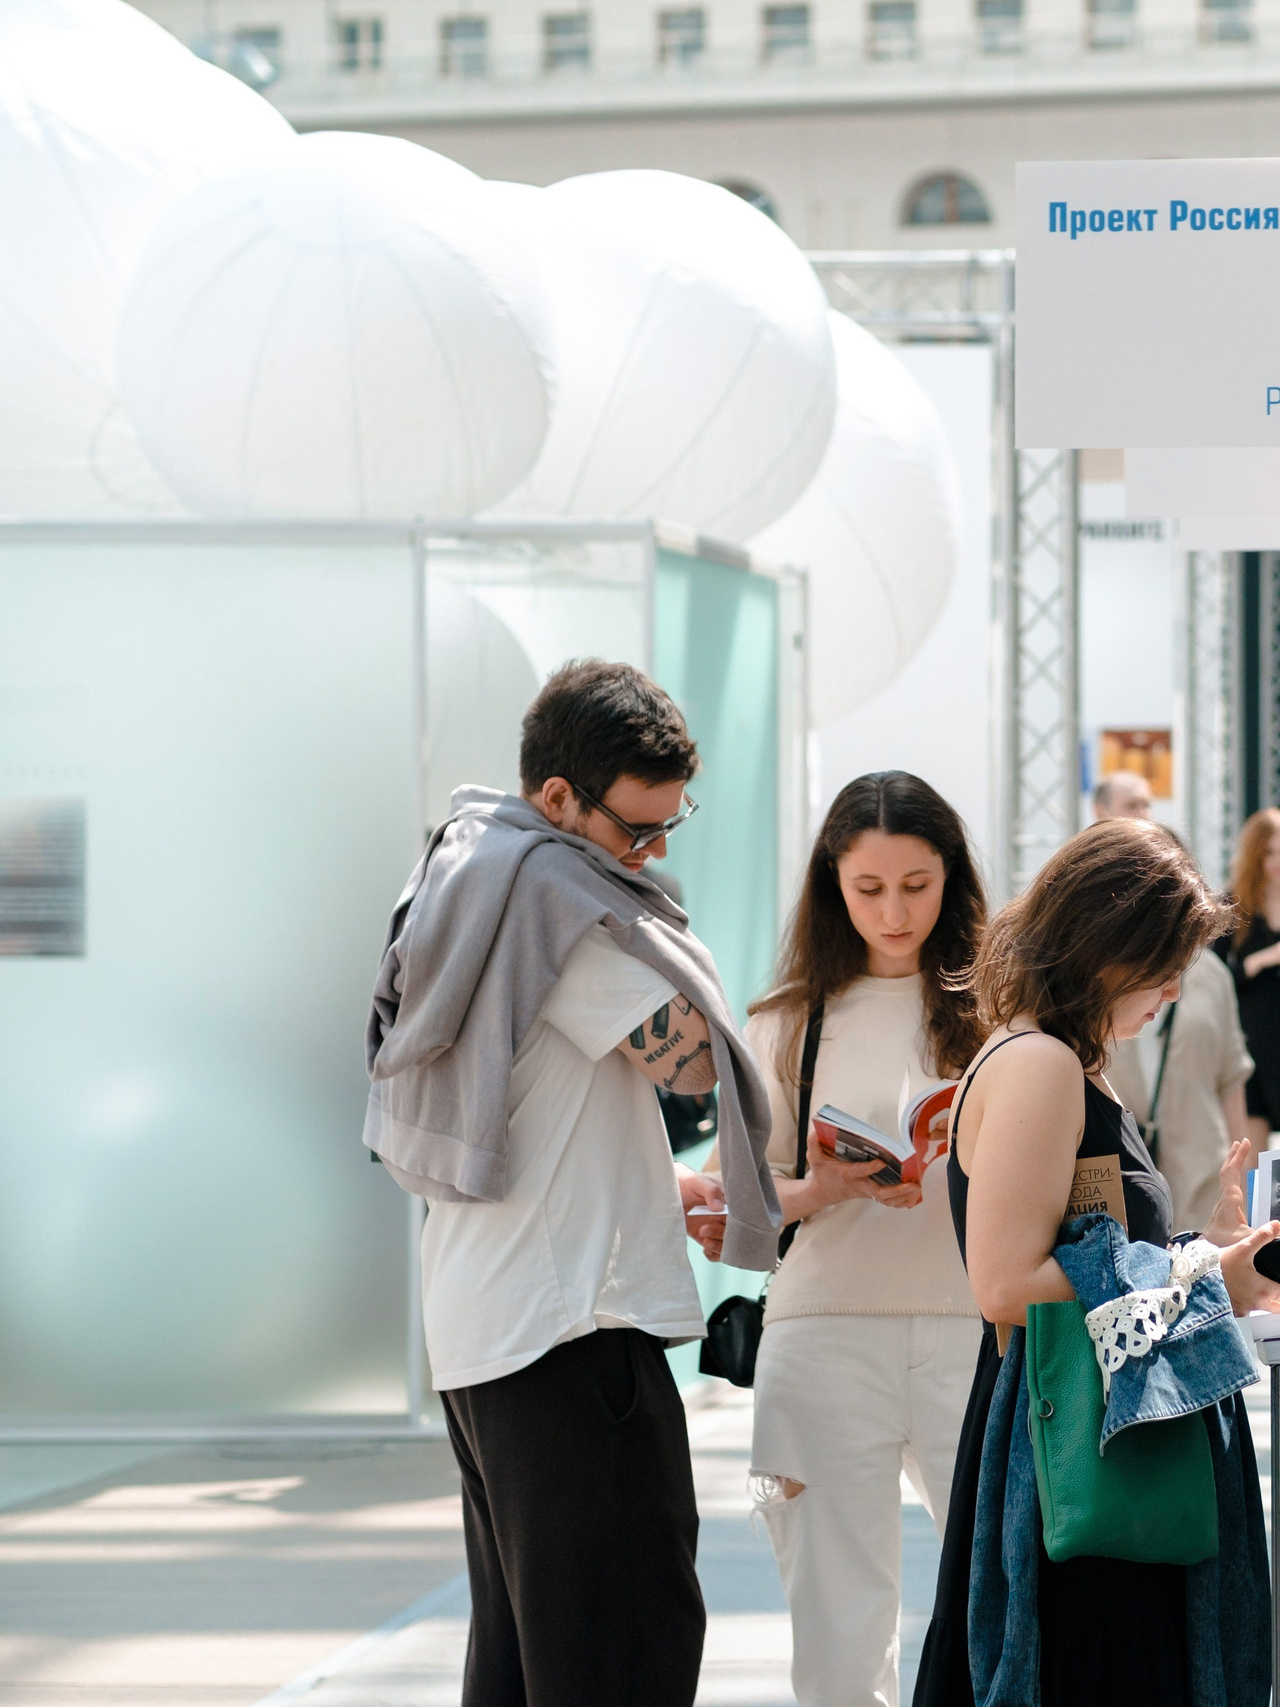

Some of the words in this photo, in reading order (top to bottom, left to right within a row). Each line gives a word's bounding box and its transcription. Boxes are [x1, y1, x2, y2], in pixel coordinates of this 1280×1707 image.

[1048, 201, 1158, 240] Проект
[1169, 199, 1280, 231] Россия
[643, 1029, 684, 1065] NEGATIVE
[1071, 1185, 1102, 1199] ОДА
[1067, 1201, 1108, 1216] АЦИЯ
